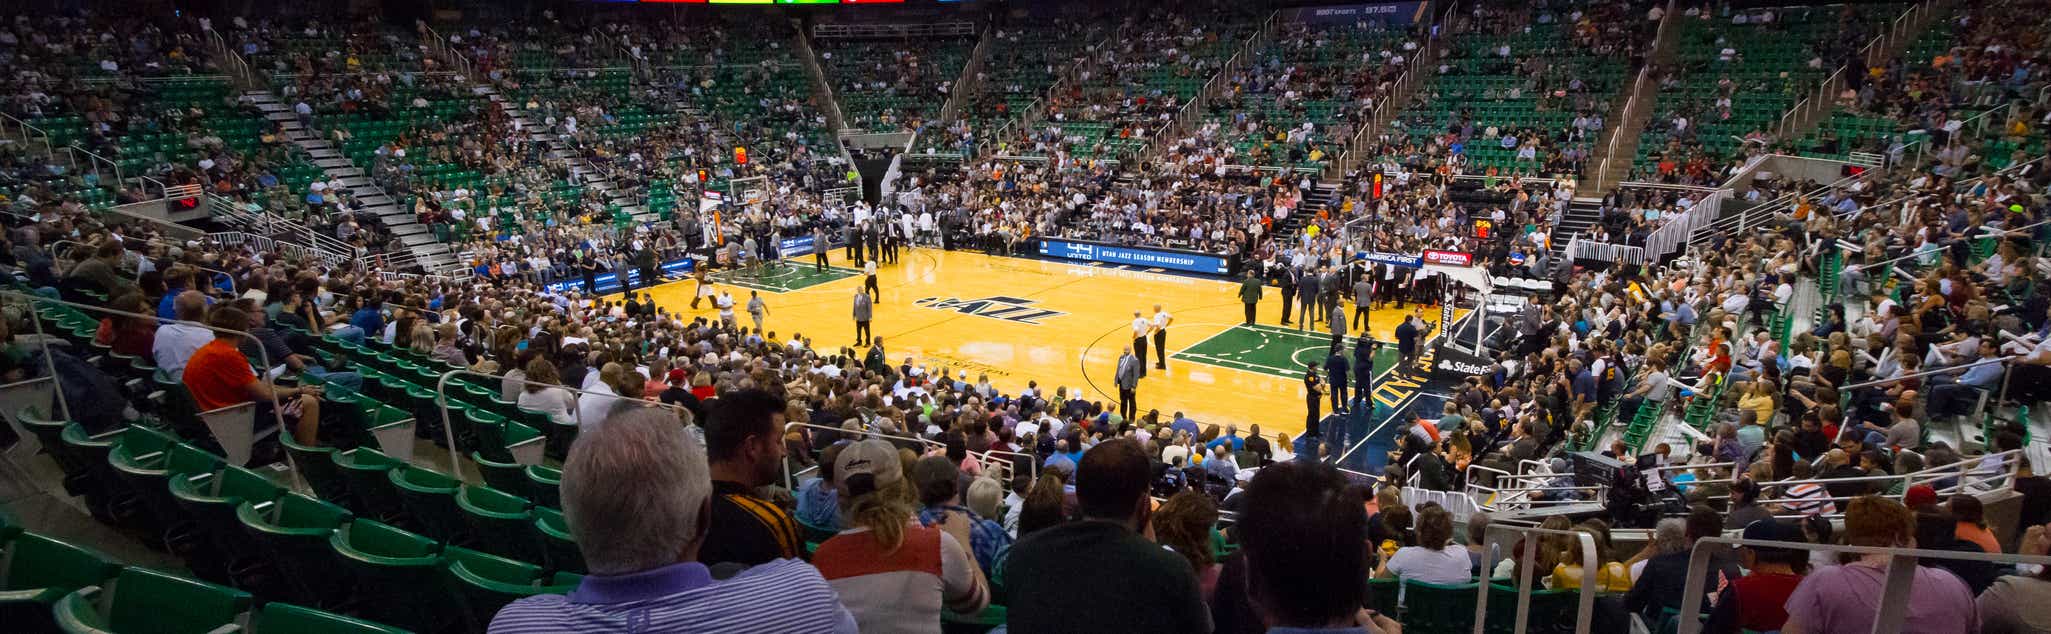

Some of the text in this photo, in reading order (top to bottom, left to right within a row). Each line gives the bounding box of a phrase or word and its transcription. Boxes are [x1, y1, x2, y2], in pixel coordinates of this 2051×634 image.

[1102, 250, 1195, 266] UTAH JAZZ SEASON MEMBERSHIP
[1365, 253, 1417, 265] AMERICA FIRST
[1440, 253, 1467, 262] TOYOTA
